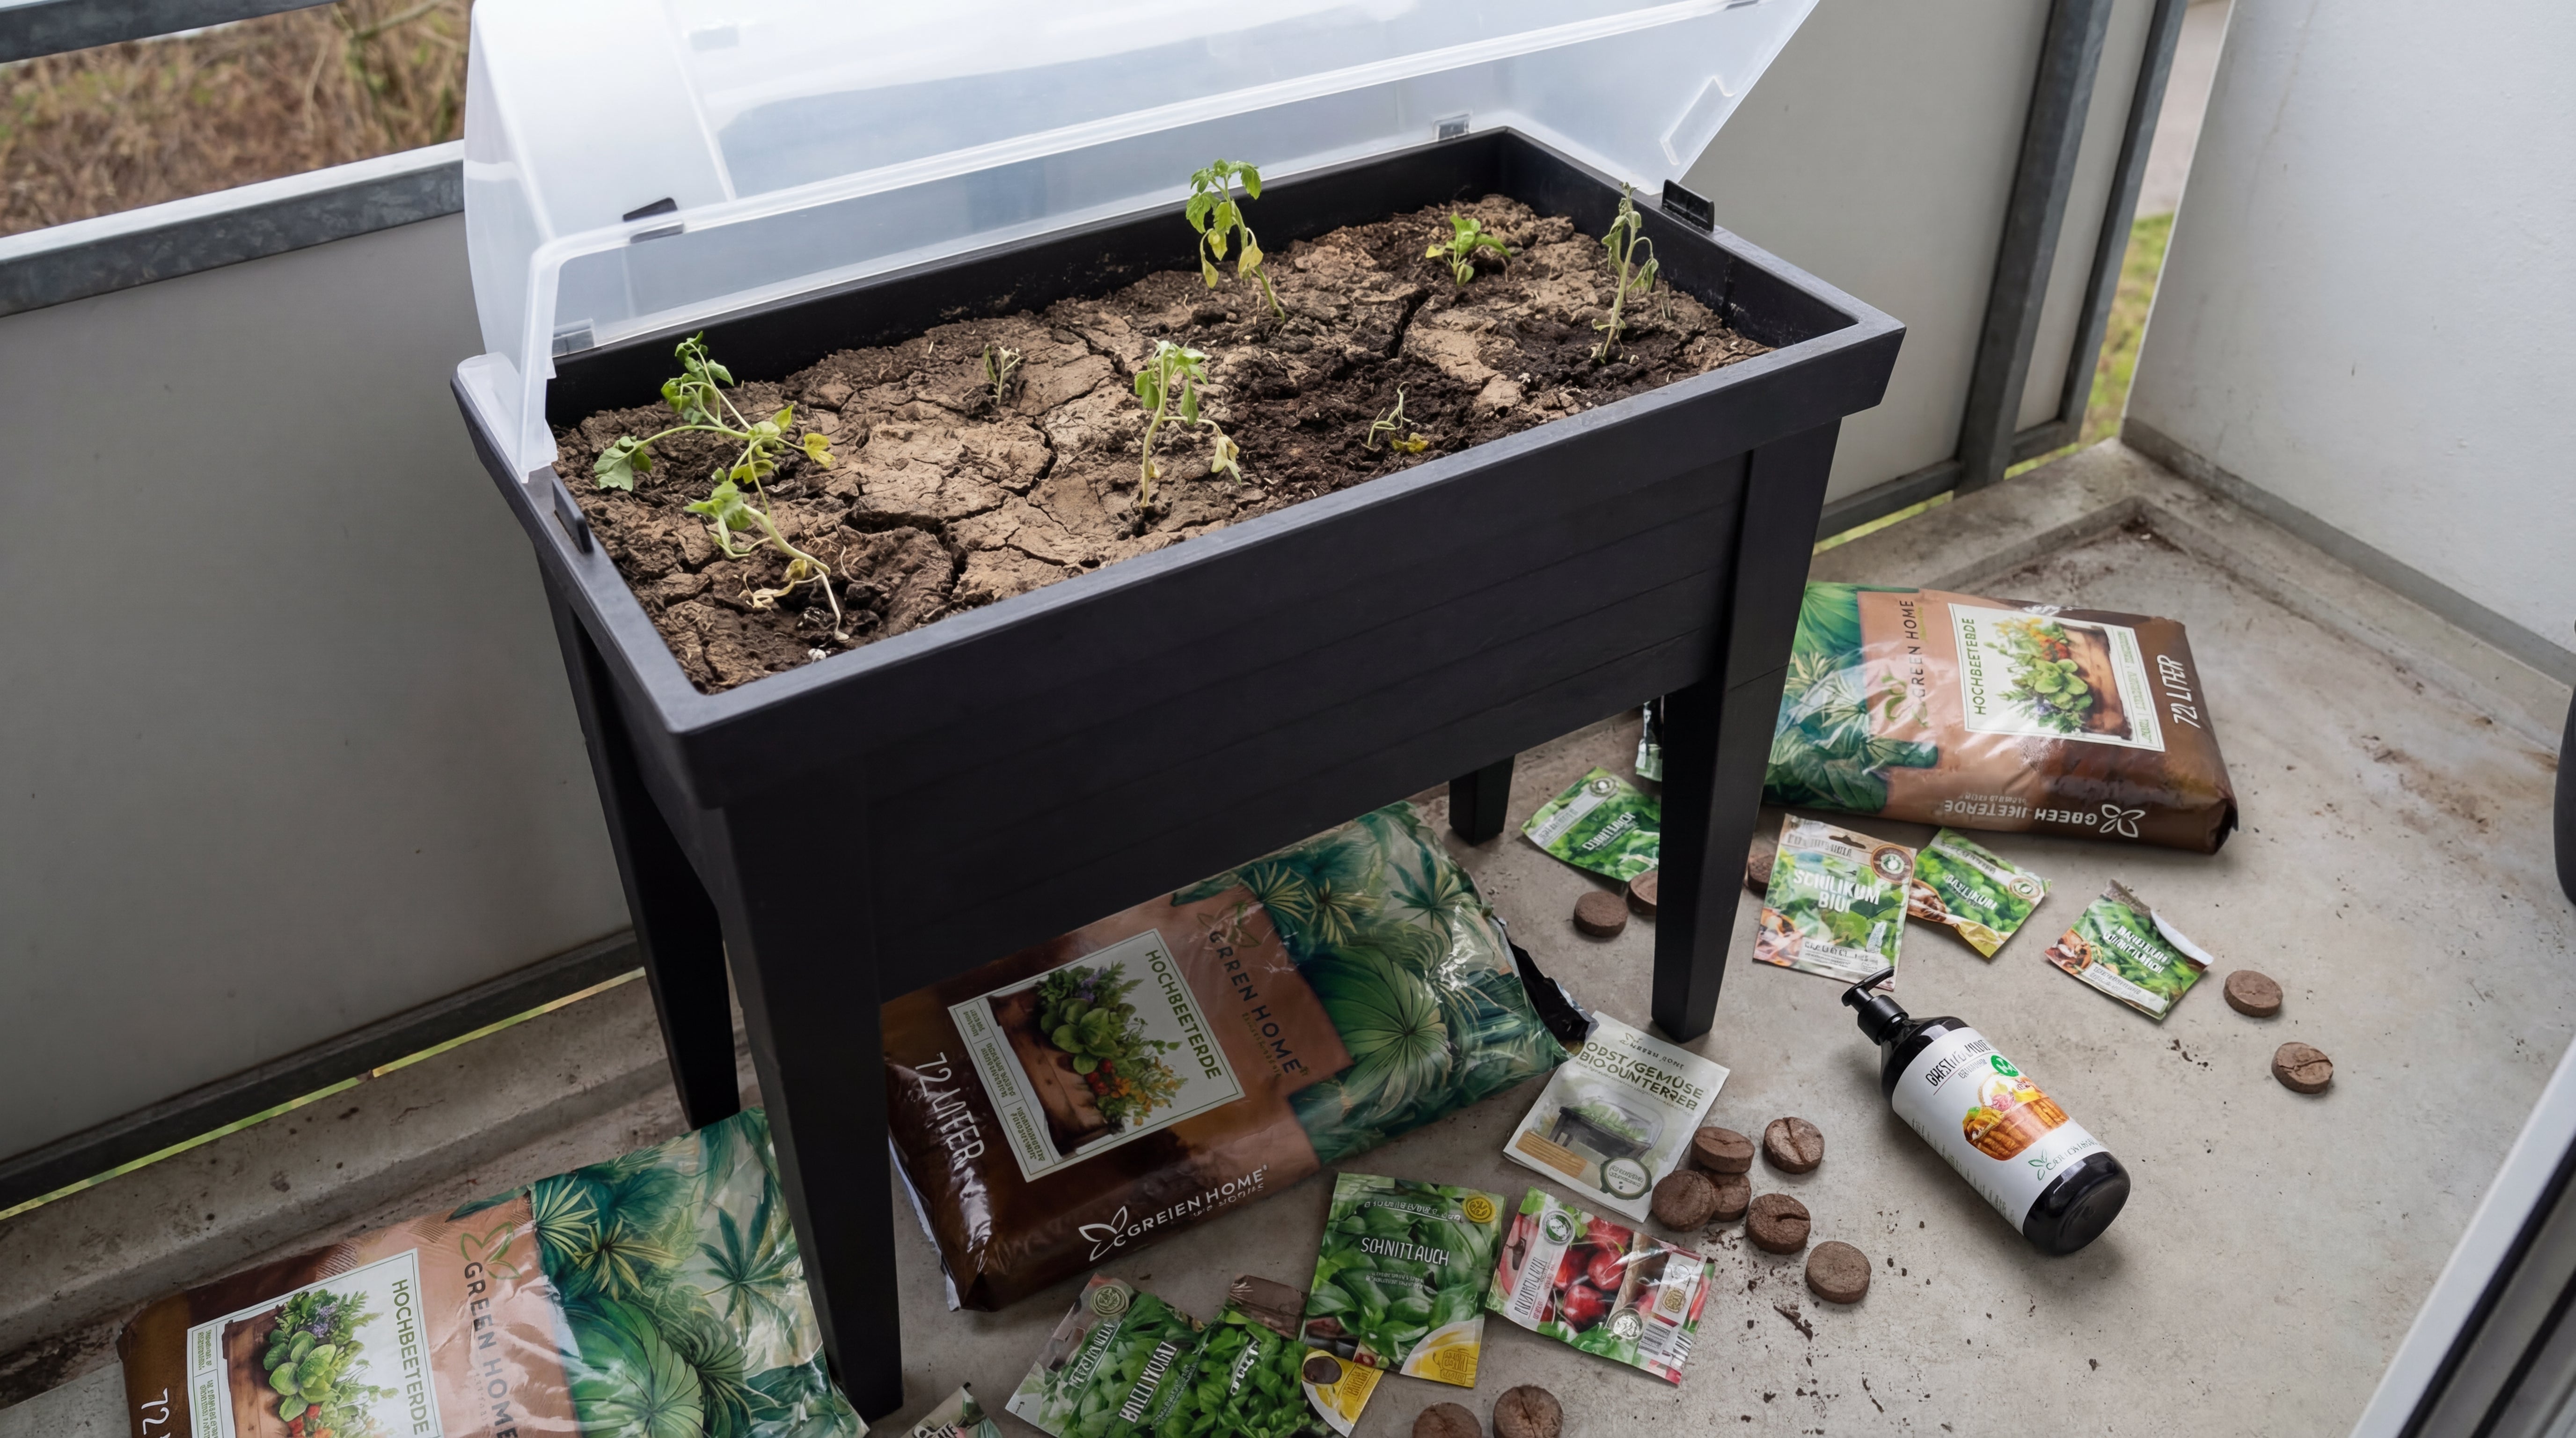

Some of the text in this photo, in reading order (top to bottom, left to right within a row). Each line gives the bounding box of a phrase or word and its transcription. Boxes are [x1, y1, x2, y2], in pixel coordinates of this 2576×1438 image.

[1899, 600, 1918, 640] HOME
[1145, 949, 1222, 1079] HOCHBEETERDE
[1251, 1005, 1302, 1073] HOME
[915, 1053, 951, 1096] 72
[1207, 1168, 1265, 1204] HOME
[465, 1262, 498, 1351] GREEN
[392, 1278, 429, 1436] HOCHBEETERDE
[141, 1387, 169, 1435] 72
